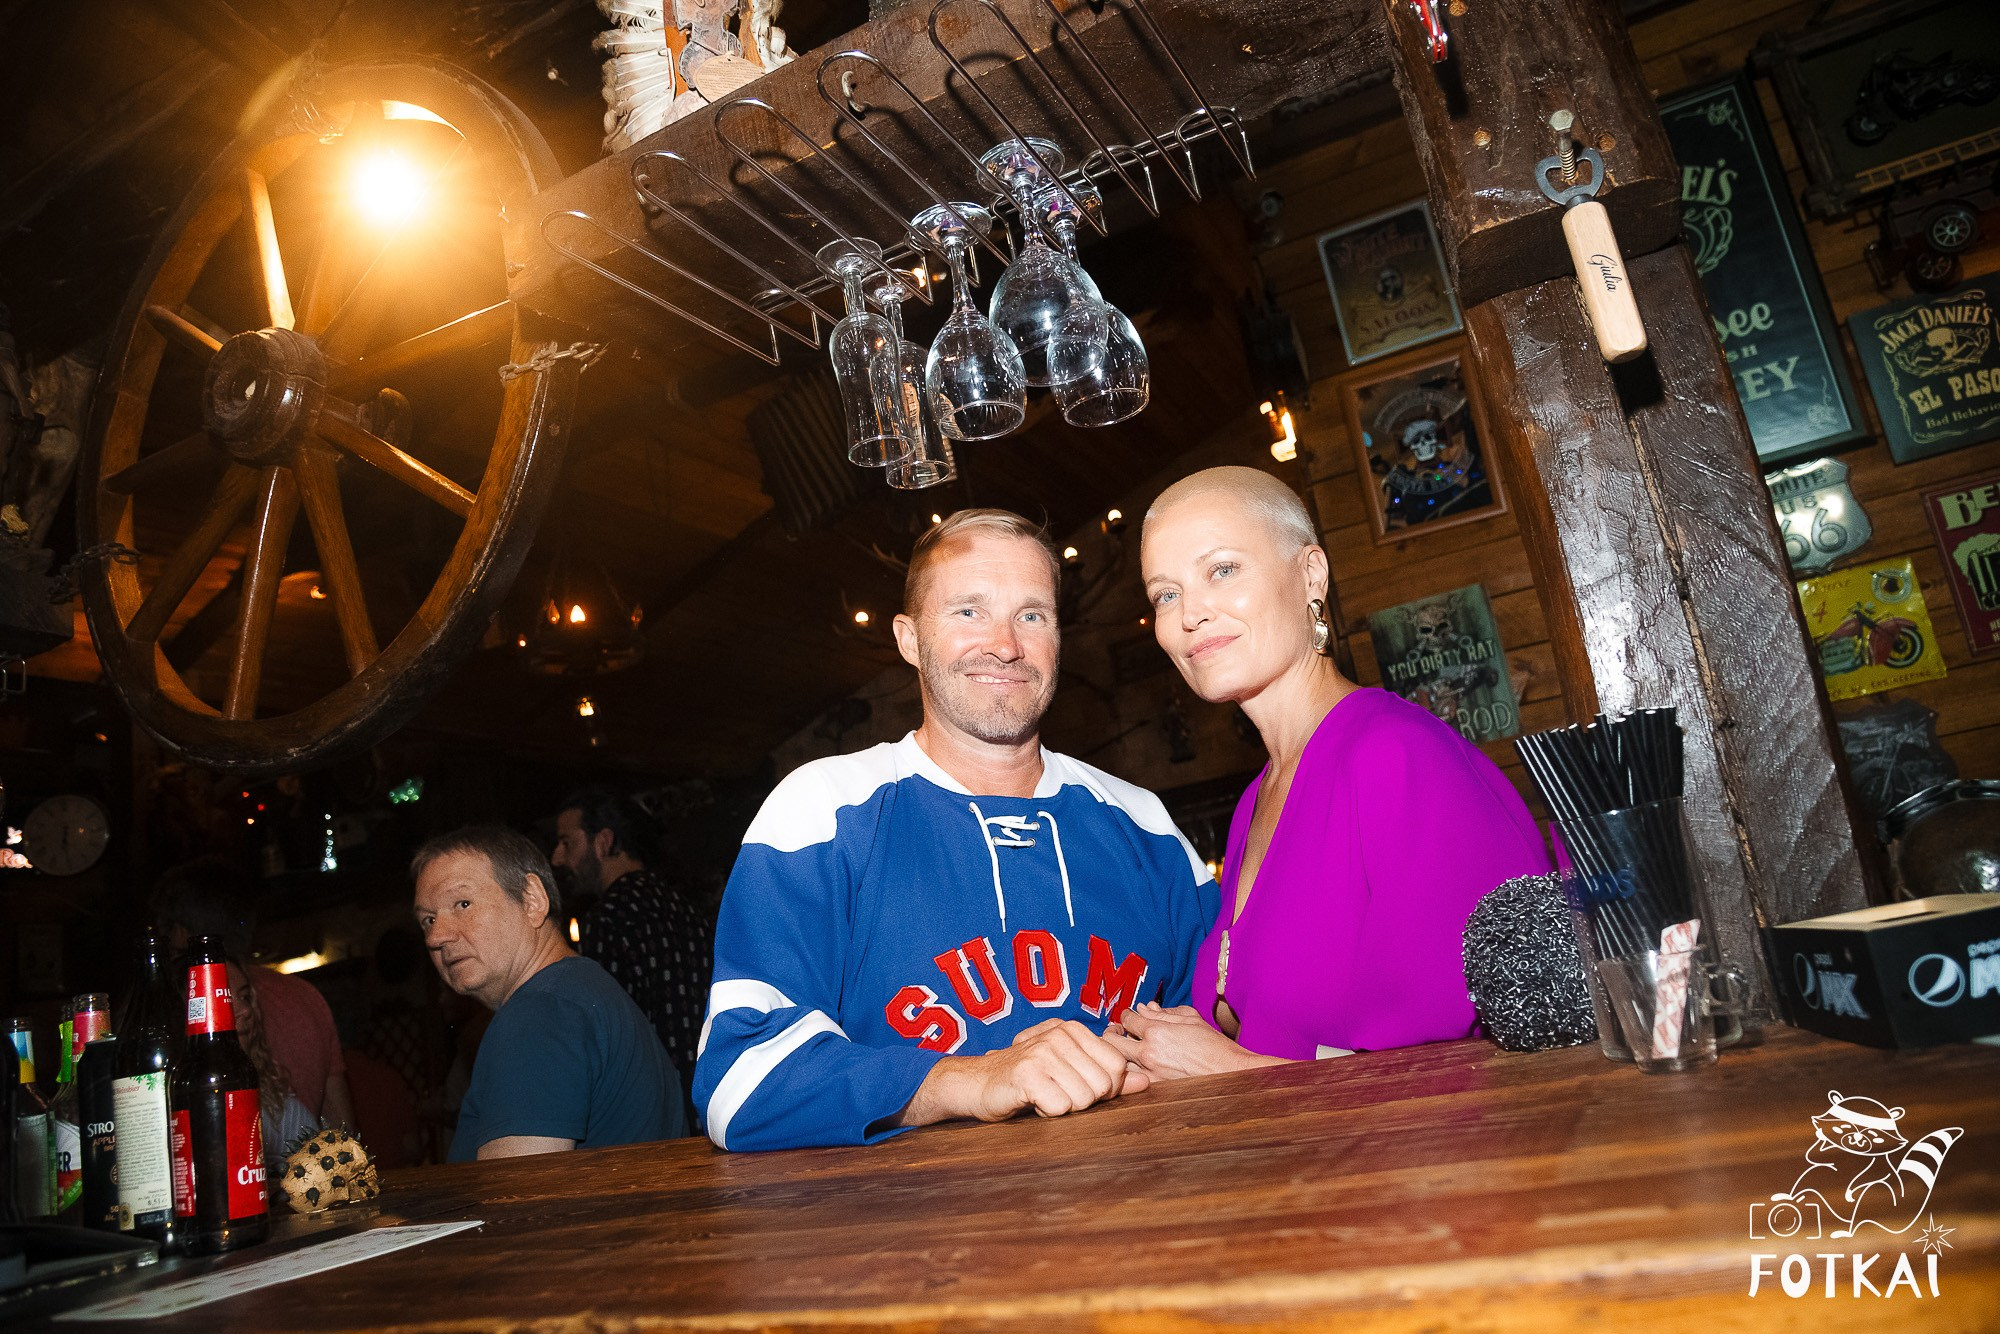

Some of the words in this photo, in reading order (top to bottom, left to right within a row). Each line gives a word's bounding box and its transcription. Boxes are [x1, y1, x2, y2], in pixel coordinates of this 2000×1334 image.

[1587, 254, 1622, 292] Giulia
[1878, 317, 1923, 354] JACK
[1917, 302, 1993, 328] DANIEL'S
[1909, 385, 1944, 415] EL
[1948, 367, 2000, 401] PASO
[1925, 414, 1950, 429] Bad
[1937, 482, 2000, 531] BE
[1387, 660, 1418, 682] YOU
[1420, 648, 1462, 674] DIRTY
[1456, 701, 1511, 741] ROD
[884, 929, 1163, 1054] SUOM
